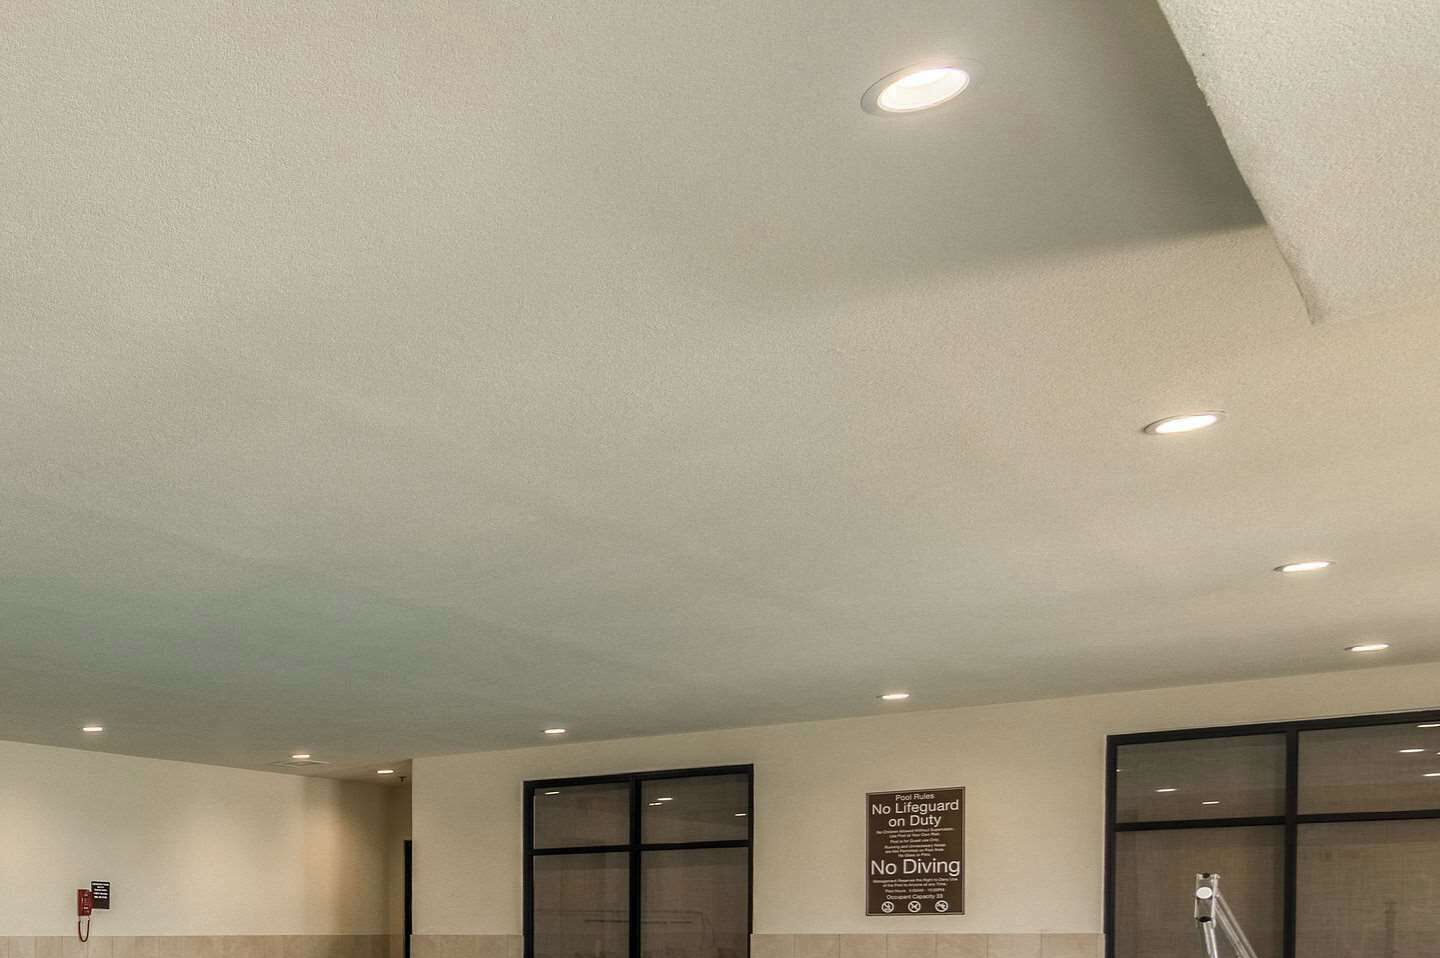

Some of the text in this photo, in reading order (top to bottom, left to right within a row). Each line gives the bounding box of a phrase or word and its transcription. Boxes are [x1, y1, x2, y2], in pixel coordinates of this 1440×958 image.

[871, 799, 959, 815] No Lifeguard
[888, 814, 942, 828] on Duty
[871, 857, 960, 877] No Diving
